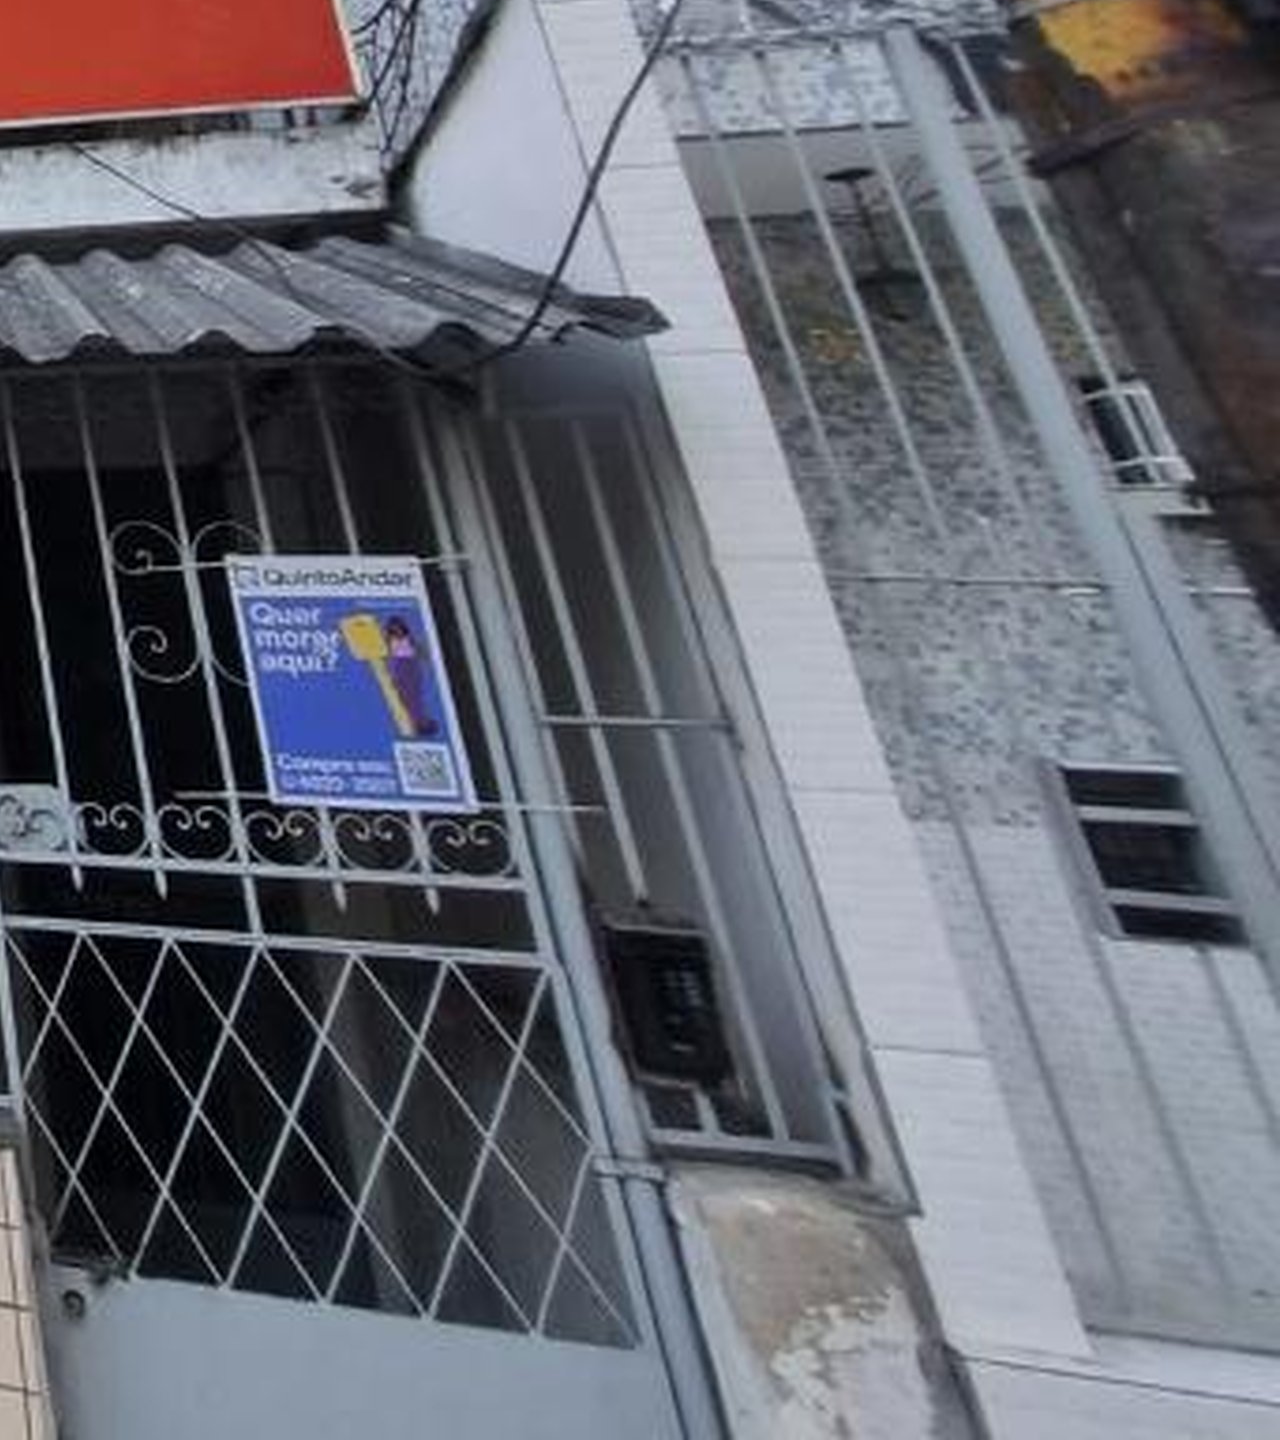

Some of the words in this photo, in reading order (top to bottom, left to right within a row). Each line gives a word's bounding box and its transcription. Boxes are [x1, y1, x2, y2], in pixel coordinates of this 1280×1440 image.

[263, 567, 413, 588] QuintoAndar
[249, 601, 320, 626] Quer
[255, 627, 339, 649] morar
[260, 650, 339, 679] aqui?
